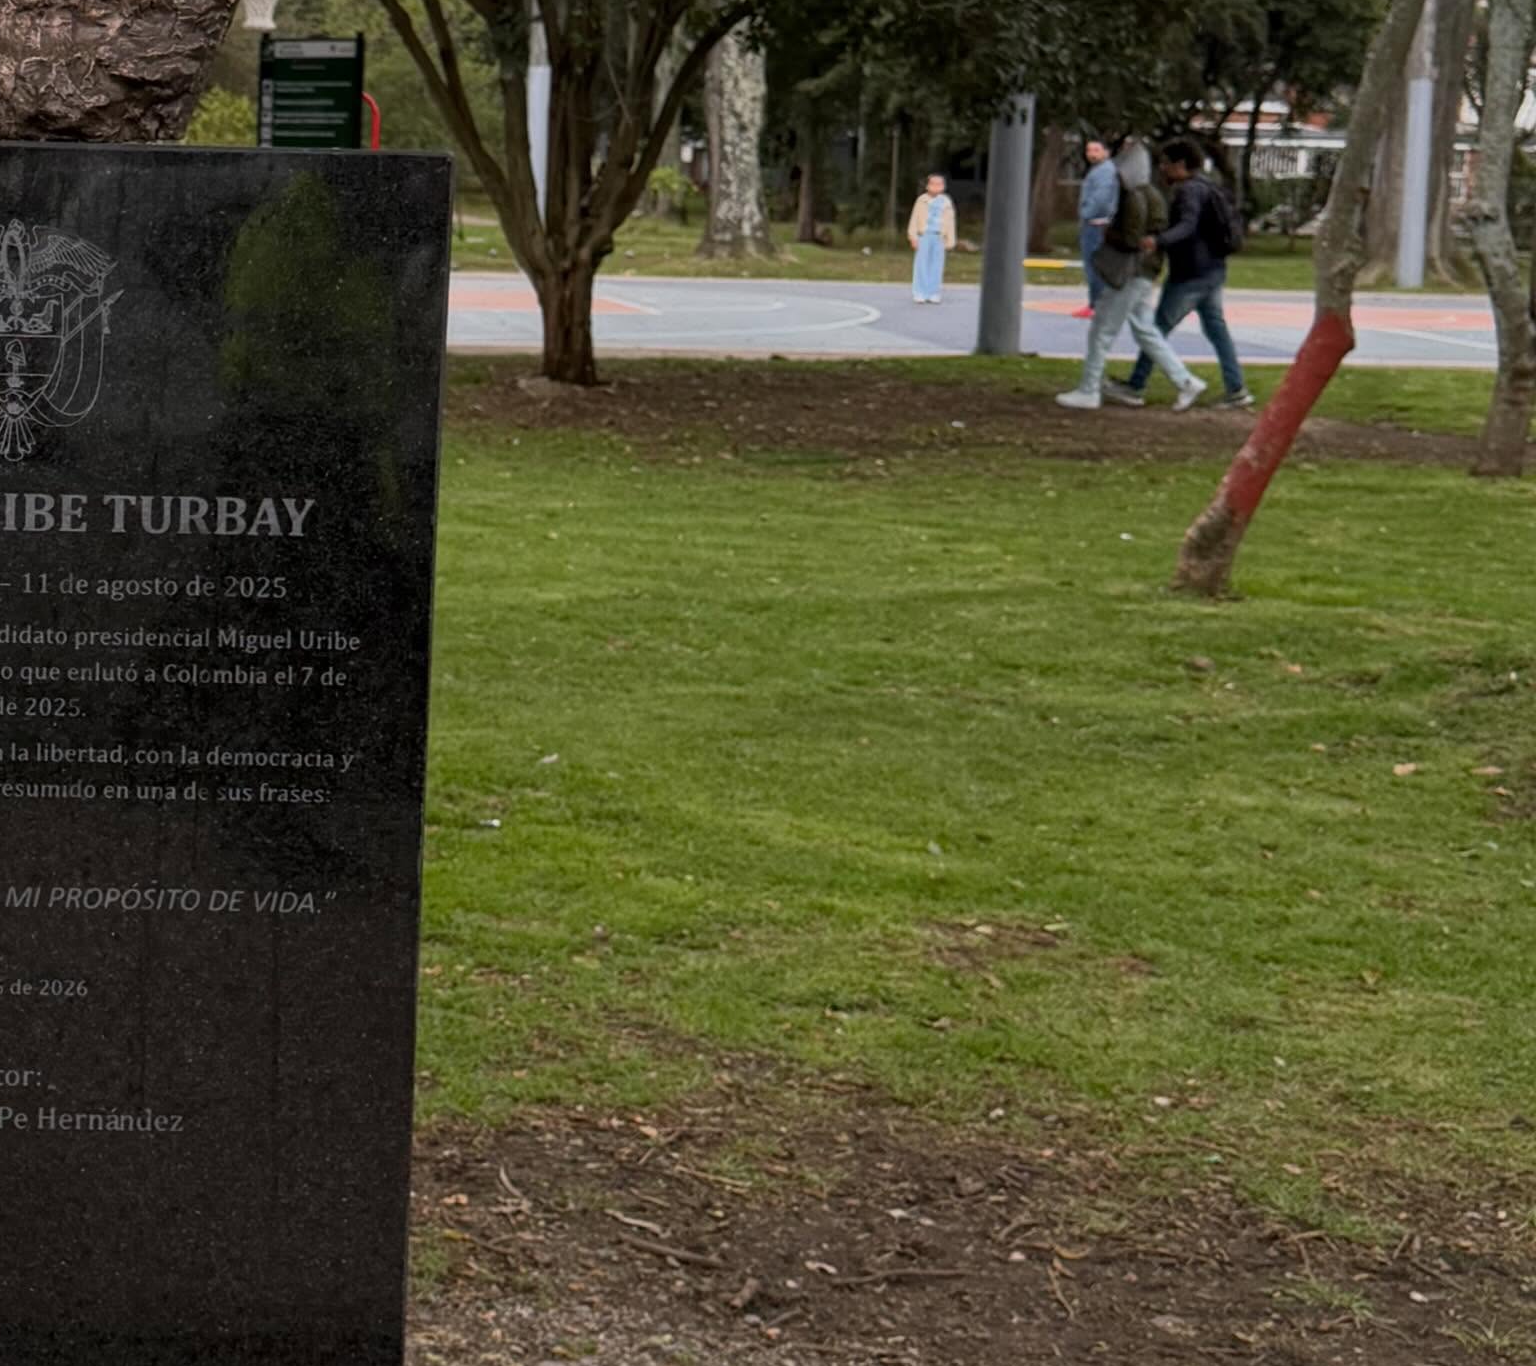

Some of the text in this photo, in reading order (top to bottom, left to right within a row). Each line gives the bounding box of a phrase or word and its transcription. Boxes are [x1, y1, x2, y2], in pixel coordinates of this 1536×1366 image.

[103, 494, 315, 536] TURBAY
[22, 572, 49, 594] 11
[59, 574, 89, 595] de
[96, 577, 179, 601] agosto
[186, 575, 215, 596] de
[224, 576, 287, 599] 2025
[74, 628, 209, 650] presidencial
[218, 629, 292, 653] Miguel
[300, 631, 360, 651] Uribe
[20, 666, 60, 685] que
[67, 662, 137, 682] enlutó
[144, 668, 155, 683] a
[163, 664, 267, 685] Colombia
[274, 666, 293, 685] el
[302, 667, 312, 685] 7
[321, 667, 347, 686] de
[24, 698, 86, 717] 2025.
[11, 743, 29, 762] la
[36, 743, 128, 765] libertad,
[135, 749, 173, 764] con
[180, 746, 199, 765] la
[206, 746, 334, 768] democracia
[340, 753, 354, 772] y
[103, 785, 129, 799] en
[136, 785, 176, 800] una
[183, 781, 208, 800] de
[217, 788, 252, 801] sus
[260, 783, 331, 803] frases:
[5, 886, 40, 908] MI
[48, 883, 201, 911] PROPÓSITO
[209, 891, 244, 912] DE
[10, 979, 32, 996] de
[39, 980, 88, 996] 2026
[38, 1108, 183, 1132] Hernández
